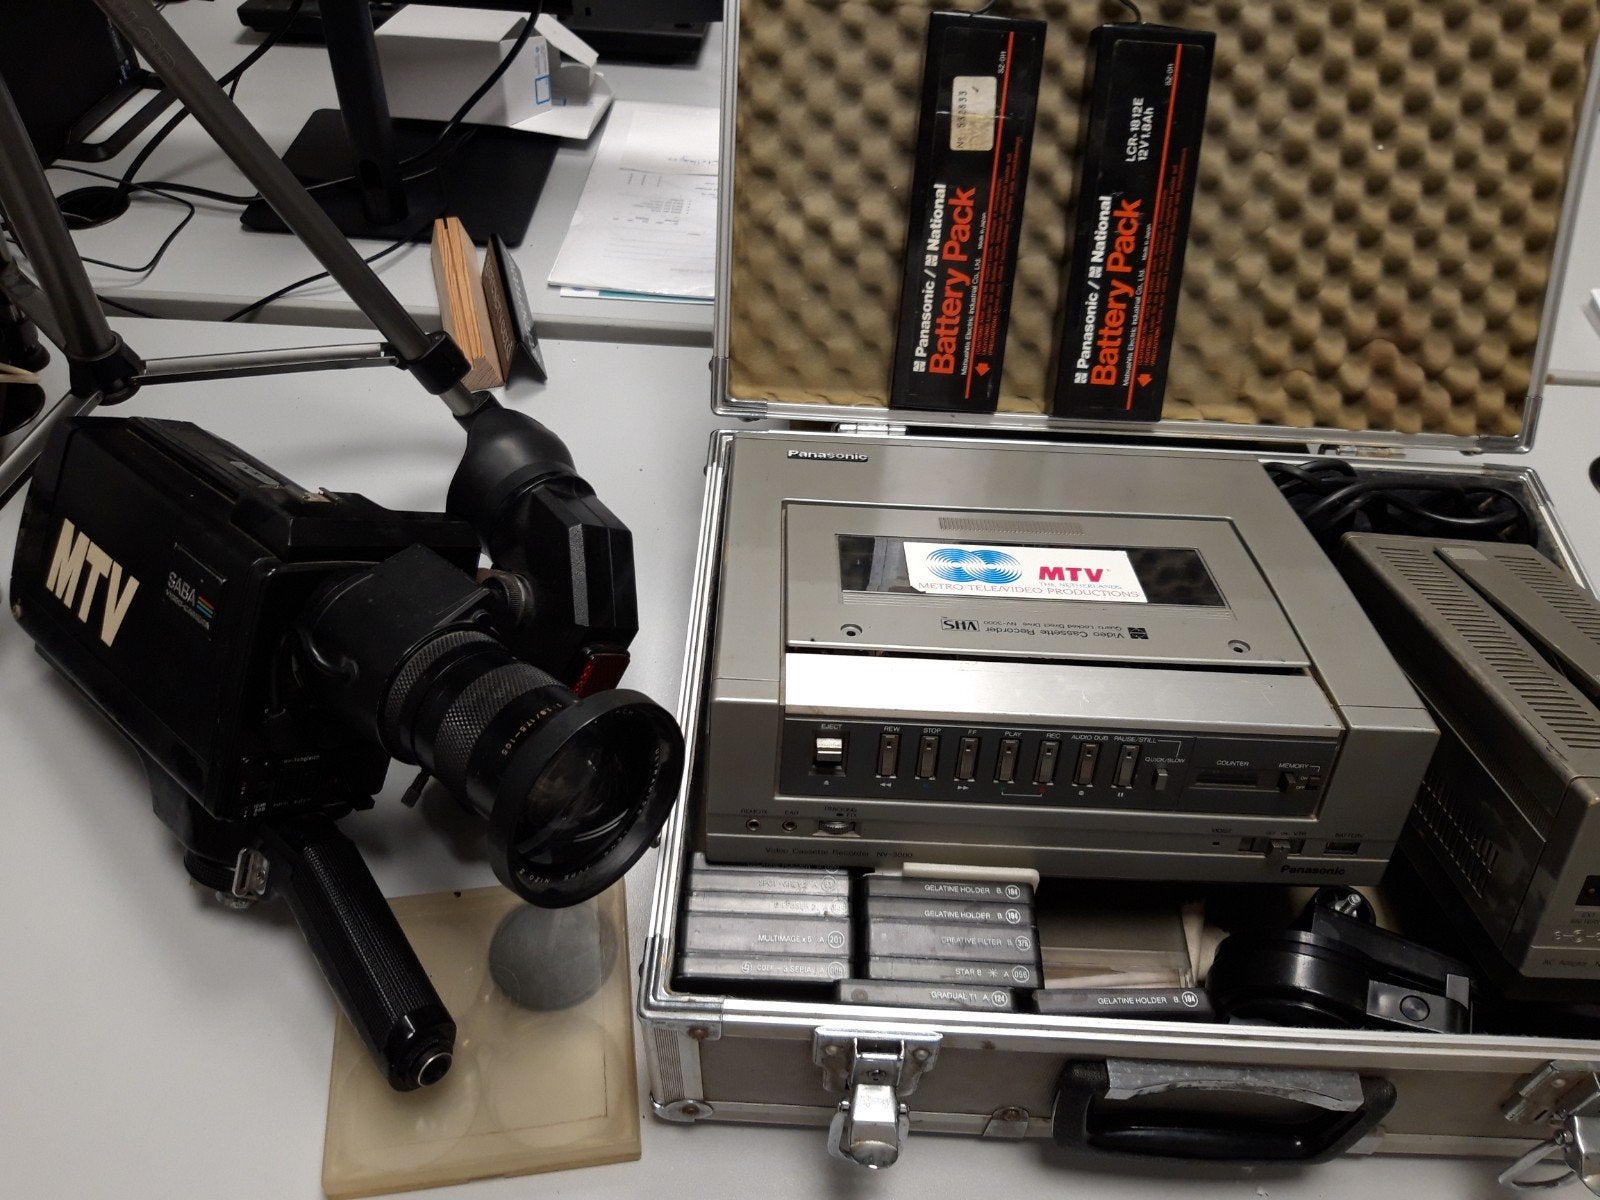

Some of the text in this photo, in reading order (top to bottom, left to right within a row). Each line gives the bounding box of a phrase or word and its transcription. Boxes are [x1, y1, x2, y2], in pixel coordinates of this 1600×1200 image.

[915, 279, 936, 358] Panasonic
[927, 183, 946, 252] National
[929, 186, 976, 374] Battery Pack
[1076, 290, 1100, 370] Panasonic
[1090, 195, 1112, 263] National
[1090, 199, 1142, 386] Battery Pack
[788, 450, 868, 460] Panasonic
[1039, 566, 1104, 582] MTV
[46, 517, 140, 648] MTV
[167, 571, 196, 606] SABA
[918, 582, 964, 591] METRO
[1047, 587, 1140, 598] PRODUCTIONS
[943, 620, 978, 632] VHS
[986, 627, 1125, 639] Video Cassette Recorder
[1114, 734, 1158, 744] PAUSE/STILL
[1216, 760, 1250, 768] COUNTER
[1278, 762, 1310, 770] MEMORY
[1280, 864, 1346, 876] Panasonic
[924, 884, 959, 892] GELATINE
[924, 910, 959, 918] GELATINE
[758, 934, 800, 942] MULTIMAGE
[942, 936, 976, 944] CREATIVE
[978, 938, 1002, 946] FILTER
[955, 968, 976, 976] STAR
[931, 990, 968, 1000] GRADUAL
